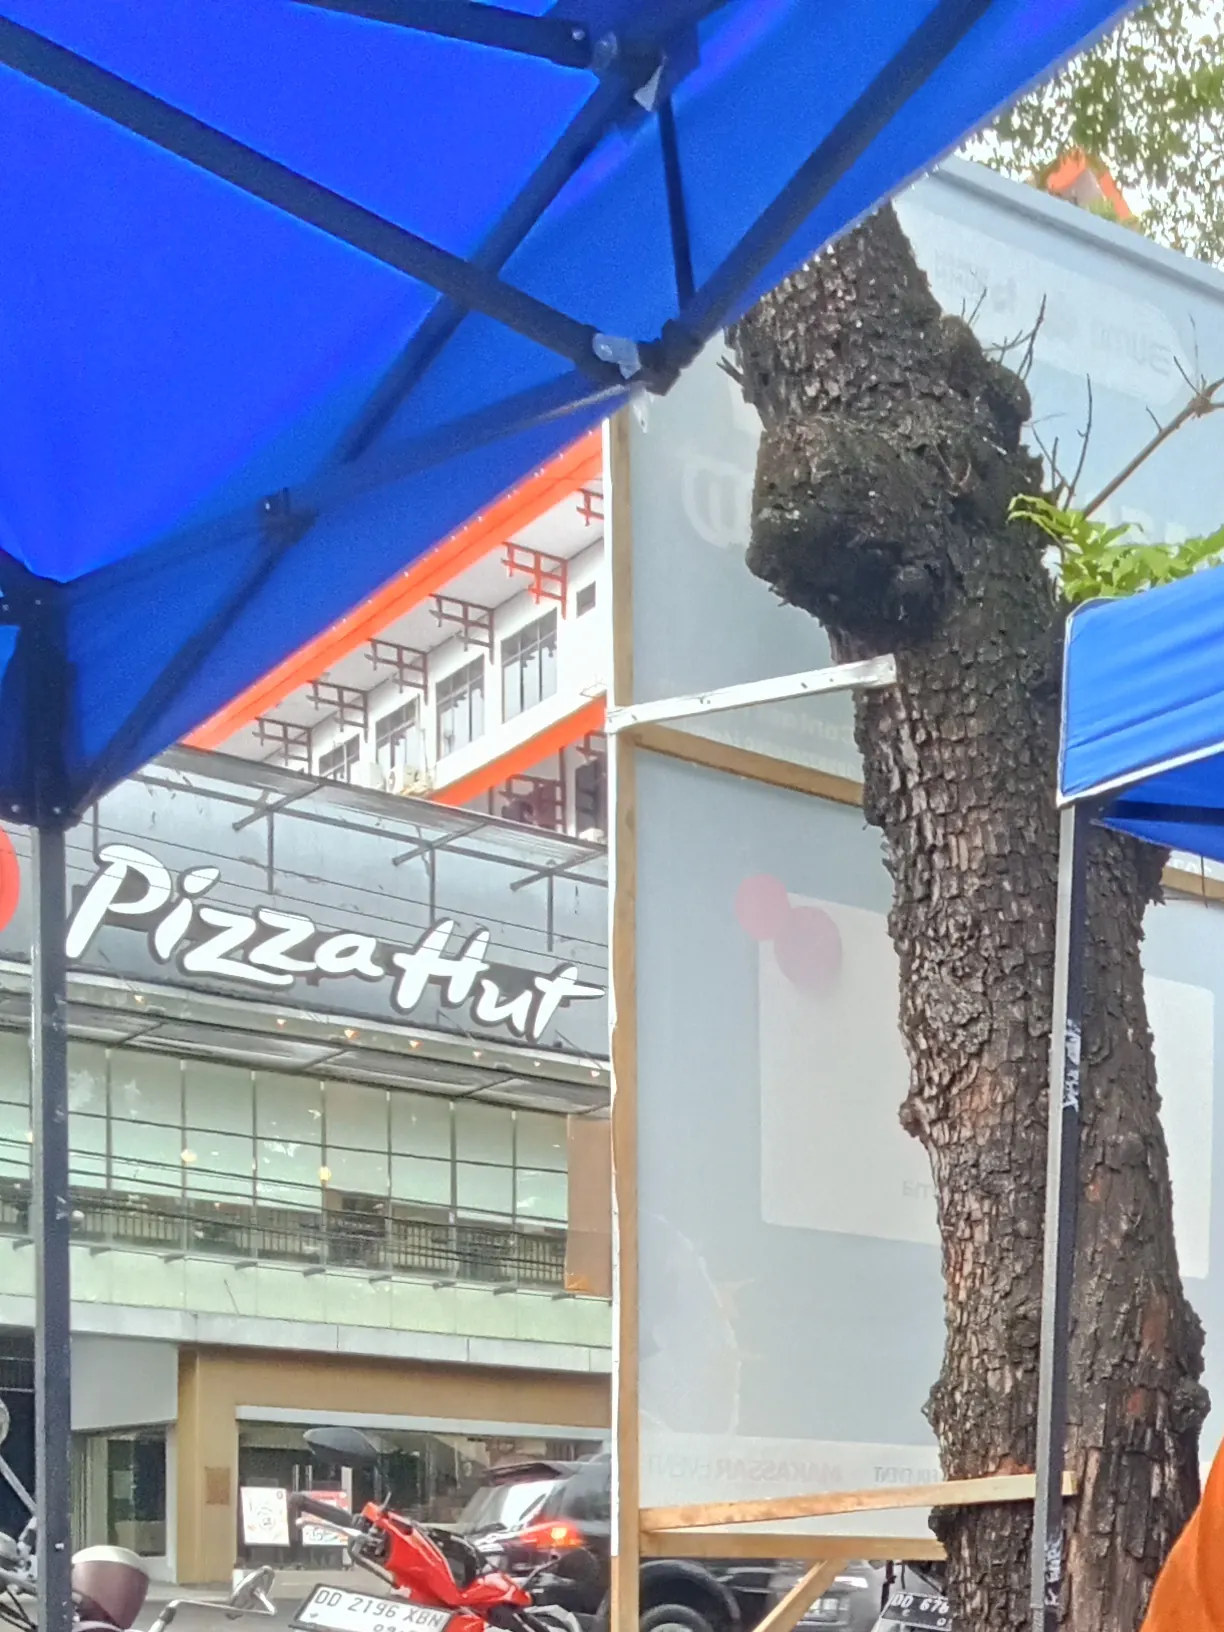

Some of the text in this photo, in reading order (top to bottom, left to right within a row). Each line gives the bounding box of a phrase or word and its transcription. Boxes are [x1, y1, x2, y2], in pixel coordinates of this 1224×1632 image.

[66, 843, 605, 1038] Pizza Hut
[313, 1589, 445, 1628] DD 2196 XBN
